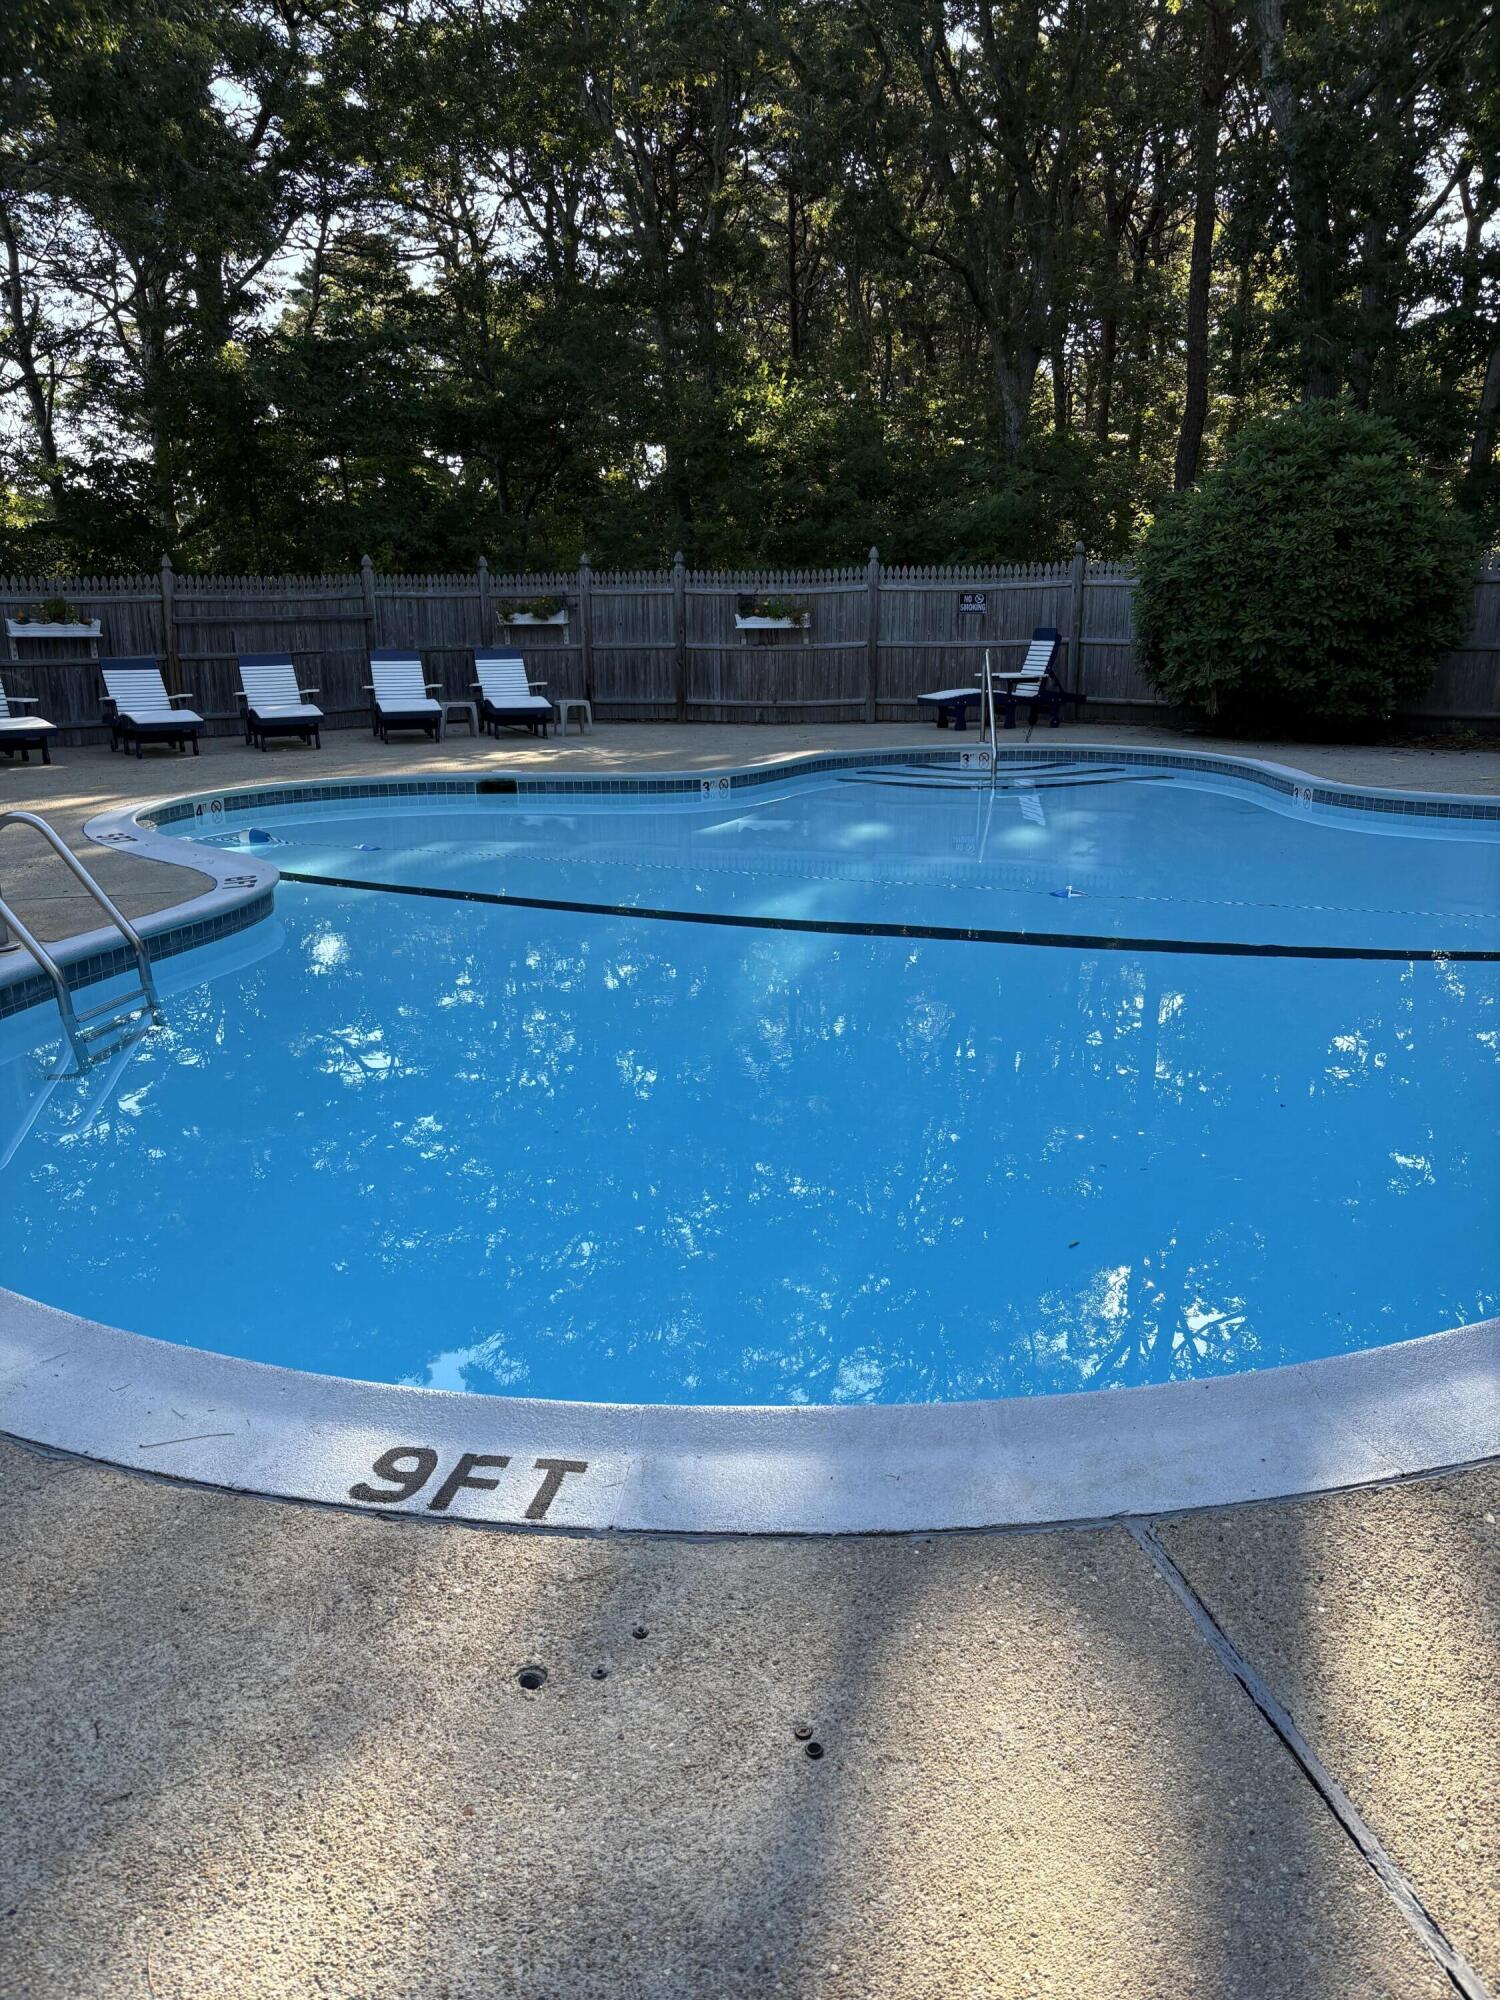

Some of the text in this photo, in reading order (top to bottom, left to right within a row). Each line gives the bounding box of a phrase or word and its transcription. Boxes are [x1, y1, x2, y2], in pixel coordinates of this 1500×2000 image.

[963, 595, 973, 603] NO
[960, 603, 986, 611] SMOKING
[348, 1446, 589, 1521] 9FT
